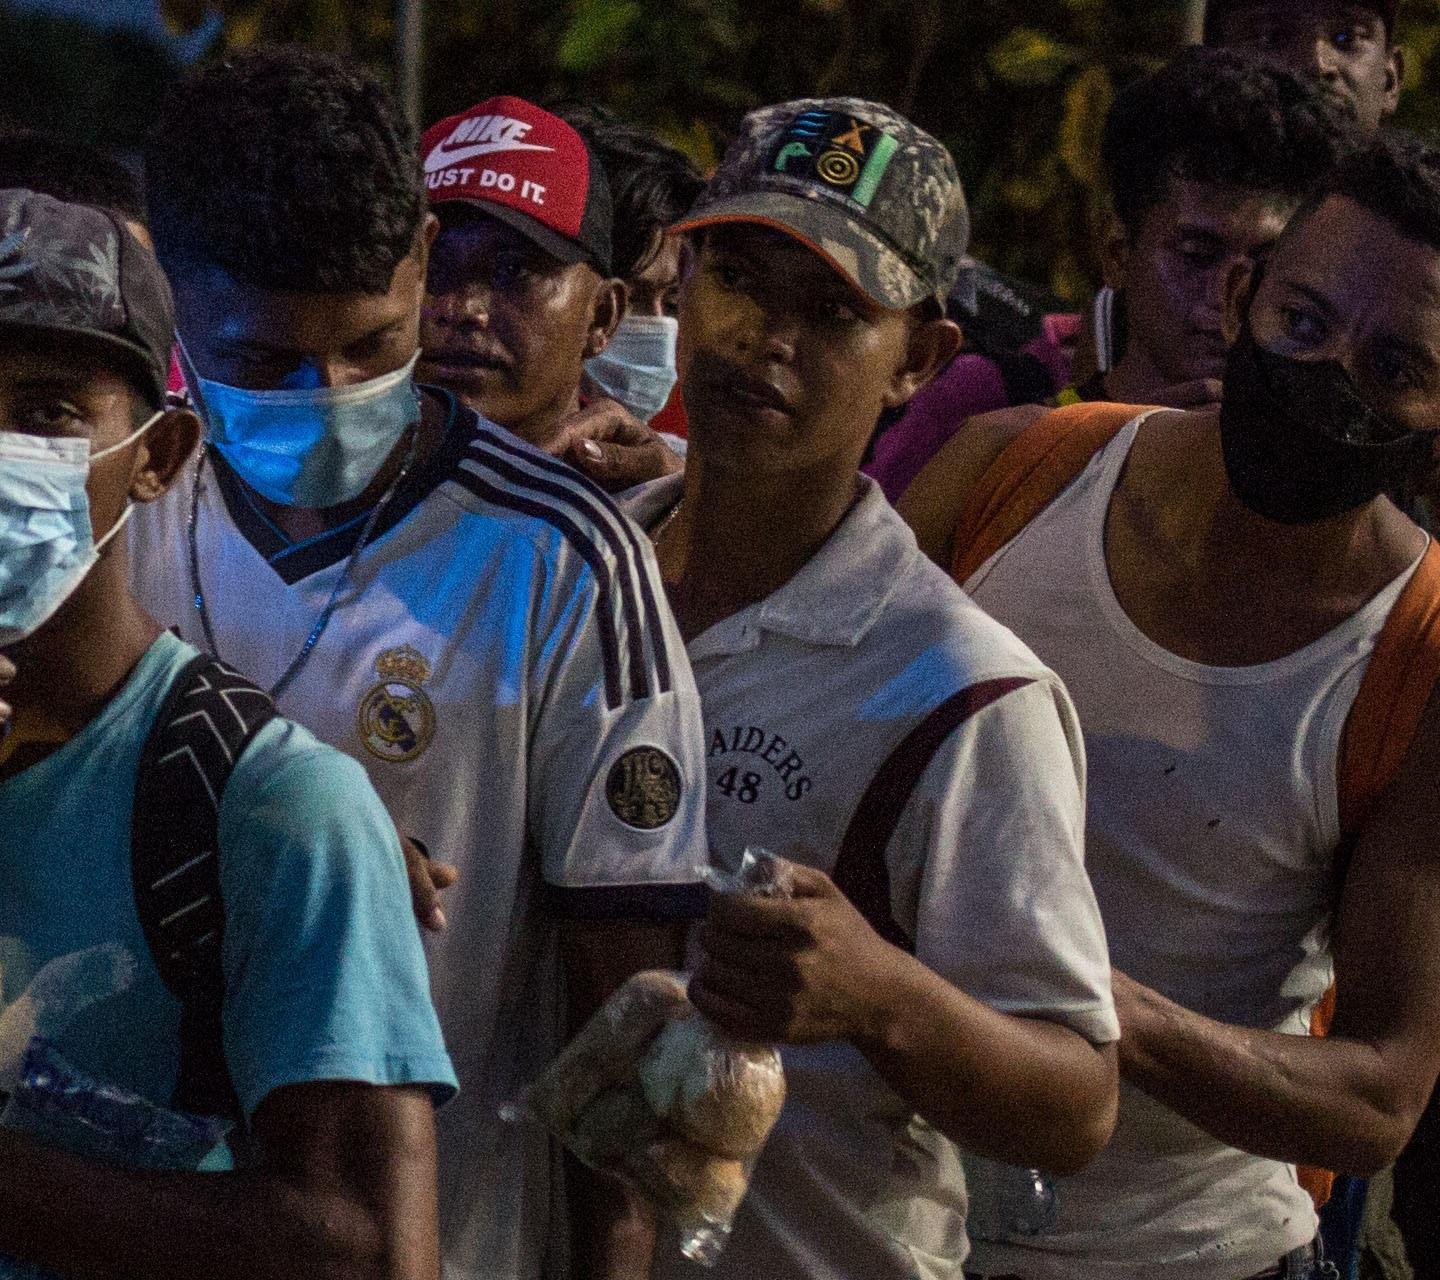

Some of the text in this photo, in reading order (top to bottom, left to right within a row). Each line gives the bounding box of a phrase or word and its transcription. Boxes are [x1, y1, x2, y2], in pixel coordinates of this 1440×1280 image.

[441, 114, 533, 146] NIKE
[479, 171, 516, 192] DO
[520, 179, 547, 206] IT.
[708, 726, 812, 802] AIDERS
[716, 766, 762, 804] 48
